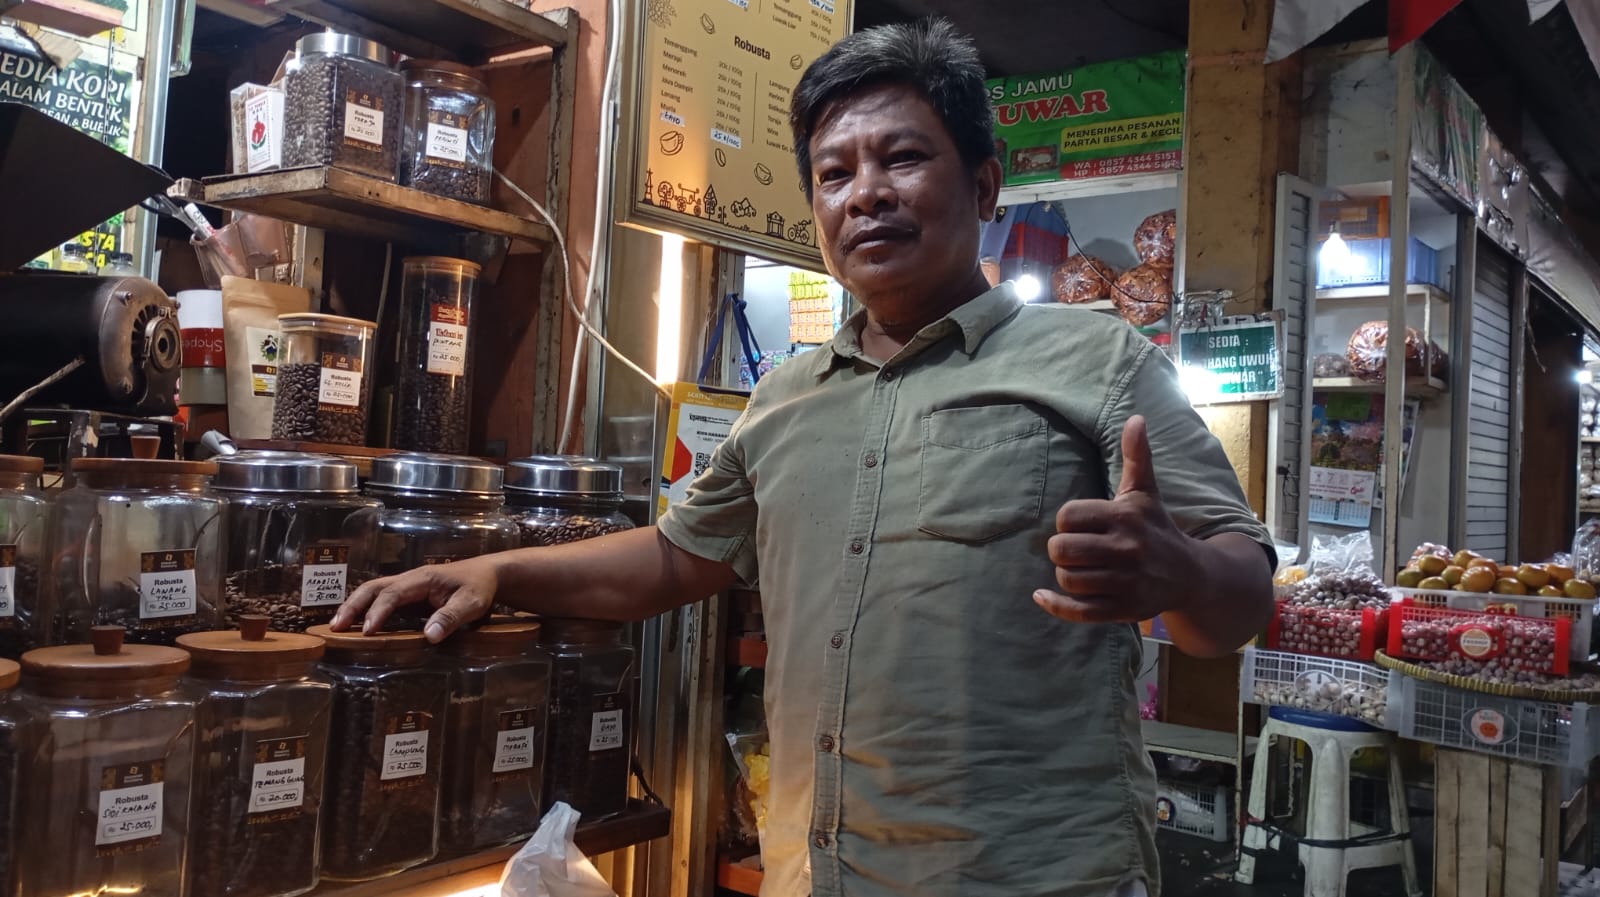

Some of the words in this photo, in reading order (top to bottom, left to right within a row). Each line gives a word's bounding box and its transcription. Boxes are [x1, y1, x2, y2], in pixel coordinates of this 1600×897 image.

[734, 35, 771, 60] Robusta
[0, 51, 58, 87] EDIA
[66, 69, 126, 103] KOPI
[1011, 73, 1073, 97] JAMU
[0, 80, 52, 105] ALAM
[993, 89, 1110, 127] UWAR
[1066, 125, 1125, 139] MENERIMA
[1127, 118, 1180, 131] PESANAN
[1064, 137, 1100, 148] PARTAI
[1103, 132, 1137, 144] BESAR
[1140, 131, 1148, 139] &
[1150, 127, 1182, 138] KECIL
[1074, 161, 1091, 170] WA
[1074, 169, 1088, 177] HP
[1208, 334, 1241, 348] SEDIA
[306, 578, 340, 586] ARABICA
[150, 586, 187, 595] LANANG
[395, 739, 418, 747] Robusta
[266, 768, 294, 777] Robusta
[115, 794, 149, 805] Robusta
